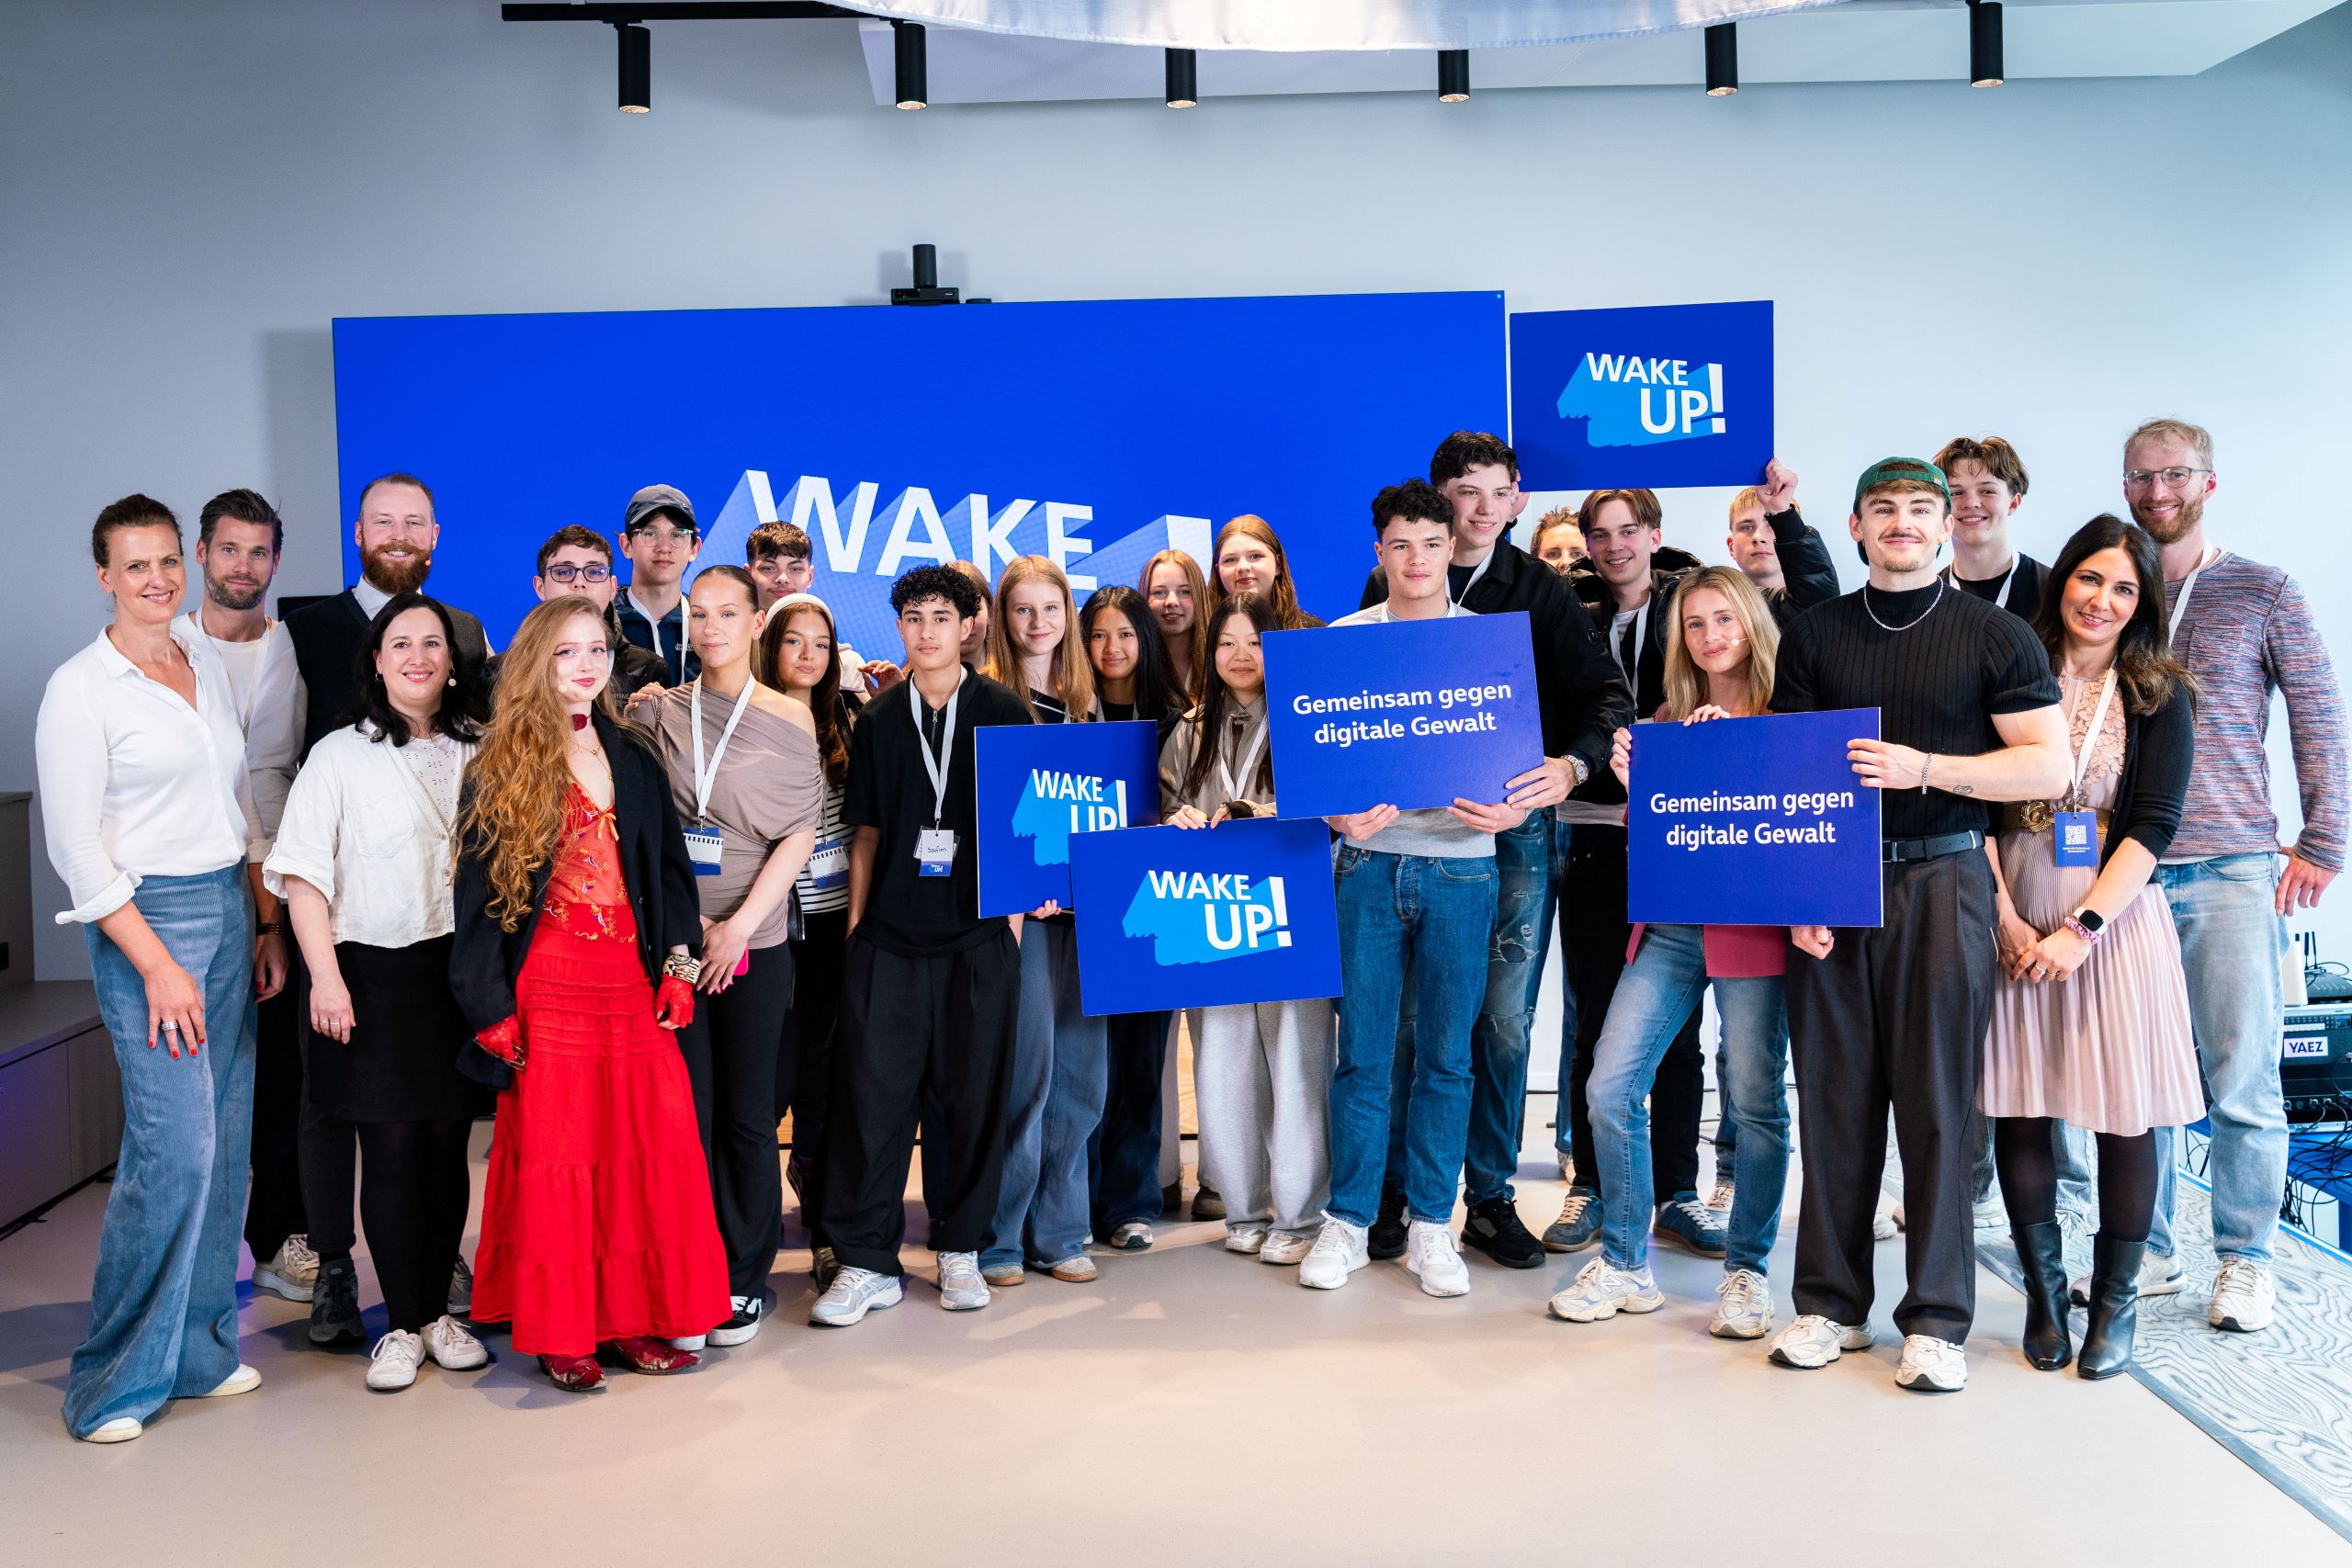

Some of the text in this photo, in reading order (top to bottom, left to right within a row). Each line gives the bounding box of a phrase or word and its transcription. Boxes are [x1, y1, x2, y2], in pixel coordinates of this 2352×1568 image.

[1586, 352, 1689, 386] WAKE
[1640, 363, 1726, 434] UP!
[745, 469, 1098, 591] WAKE
[1293, 684, 1513, 715] Gemeinsam gegen
[1314, 711, 1498, 748] digitale Gewalt
[1032, 768, 1103, 803] WAKE
[1650, 790, 1855, 817] Gemeinsam gegen
[1666, 820, 1837, 852] digitale Gewalt
[1148, 870, 1251, 901] WAKE
[1204, 876, 1293, 951] UP!
[2289, 1041, 2324, 1054] YAEZ
